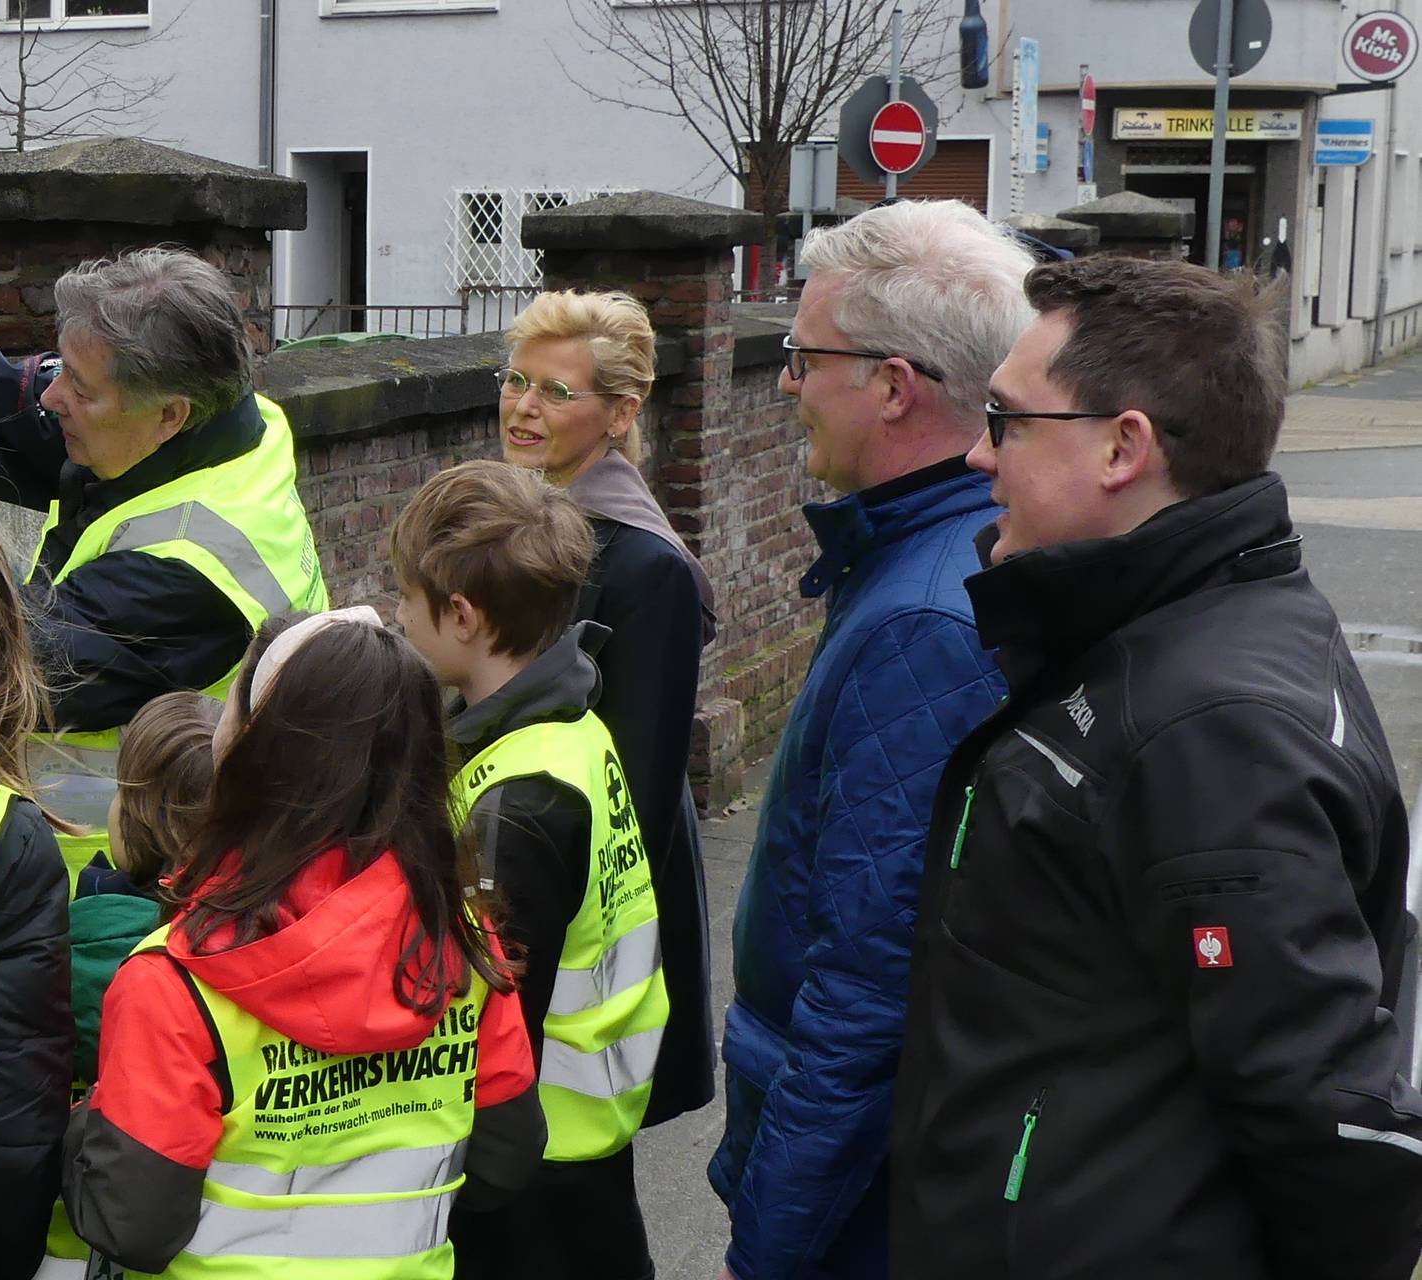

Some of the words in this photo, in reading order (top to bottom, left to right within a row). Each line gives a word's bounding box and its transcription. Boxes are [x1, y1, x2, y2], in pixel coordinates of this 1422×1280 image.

[1371, 26, 1398, 47] Mc
[1354, 36, 1403, 64] Kiosk
[1166, 117, 1254, 132] TRINKHLLE
[1329, 138, 1369, 148] Hermes
[1066, 696, 1096, 738] DEKRA
[254, 1040, 478, 1110] VERKEHRSWACHT
[254, 1097, 443, 1142] www.vekehrswacht-muelheim.de
[307, 1108, 321, 1118] an
[324, 1104, 340, 1115] der
[342, 1097, 361, 1111] Ruhr
